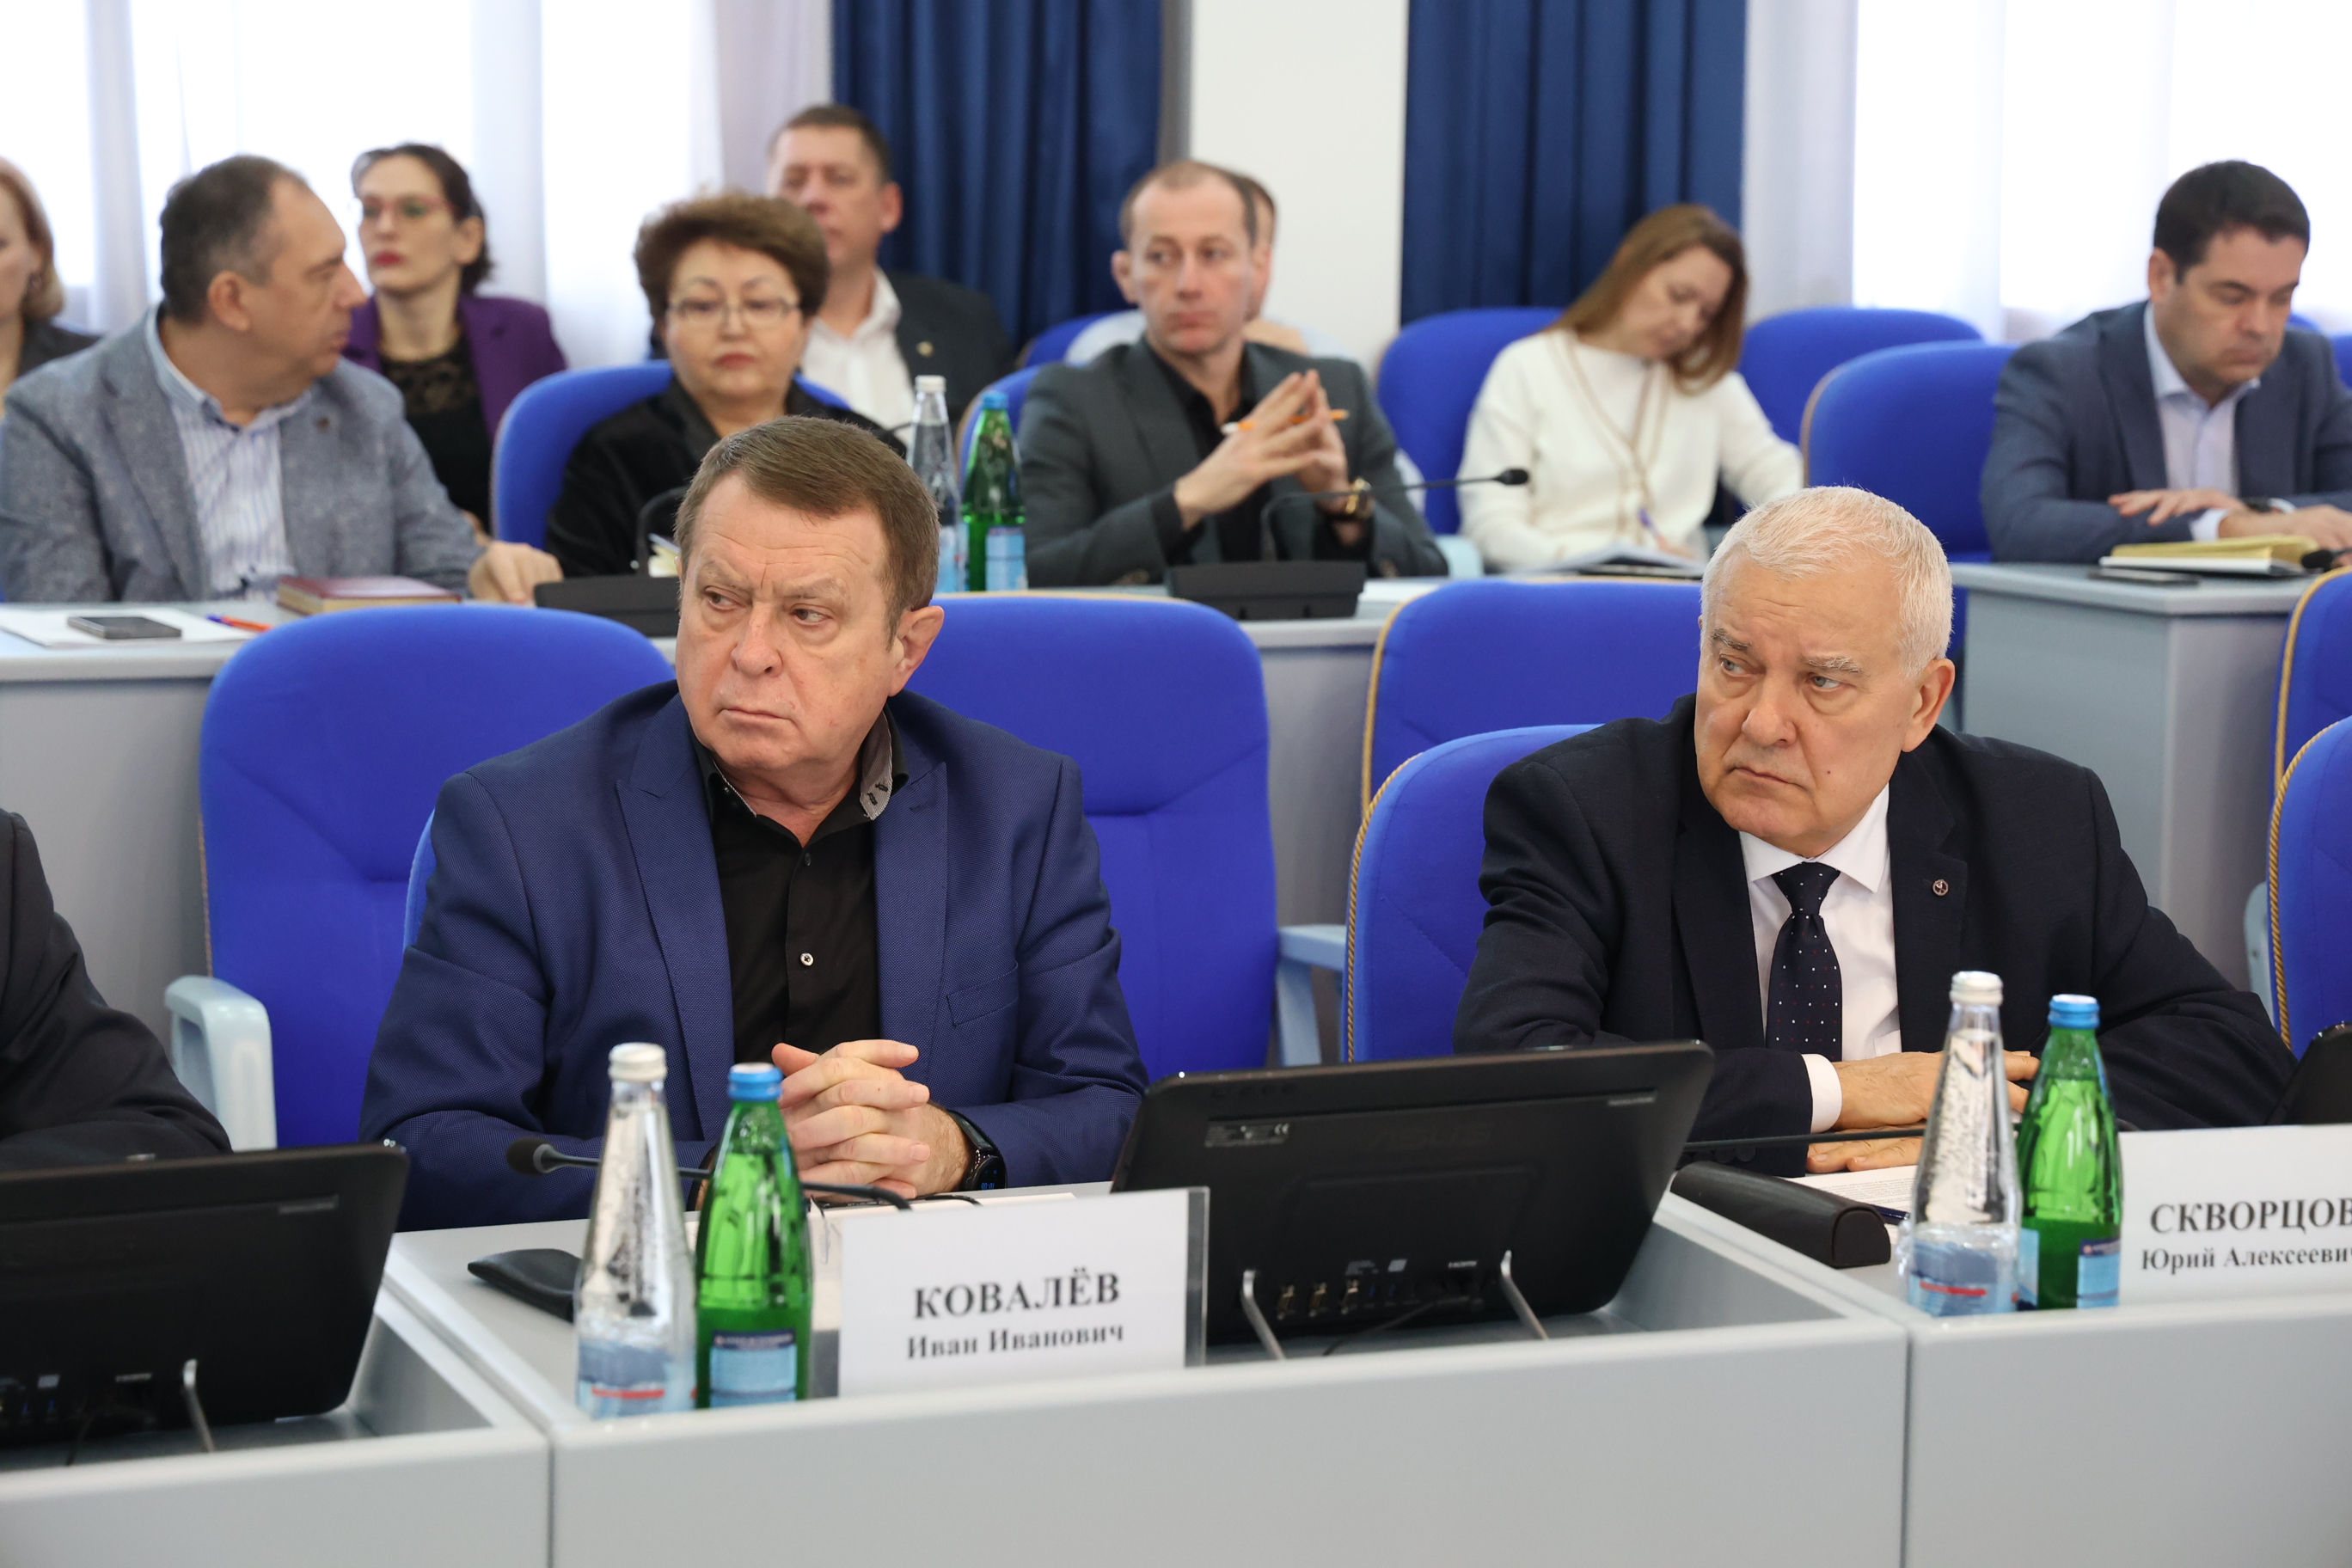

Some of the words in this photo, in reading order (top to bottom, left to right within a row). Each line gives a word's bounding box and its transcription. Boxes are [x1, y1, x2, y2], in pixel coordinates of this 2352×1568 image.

[2150, 1197, 2352, 1235] СКВОРЦОВ
[2141, 1246, 2215, 1275] Юрий
[2223, 1246, 2352, 1268] Алексееви
[914, 1267, 1122, 1320] КОВАЛЁВ
[907, 1335, 978, 1360] Иван
[989, 1323, 1124, 1353] Иванович
